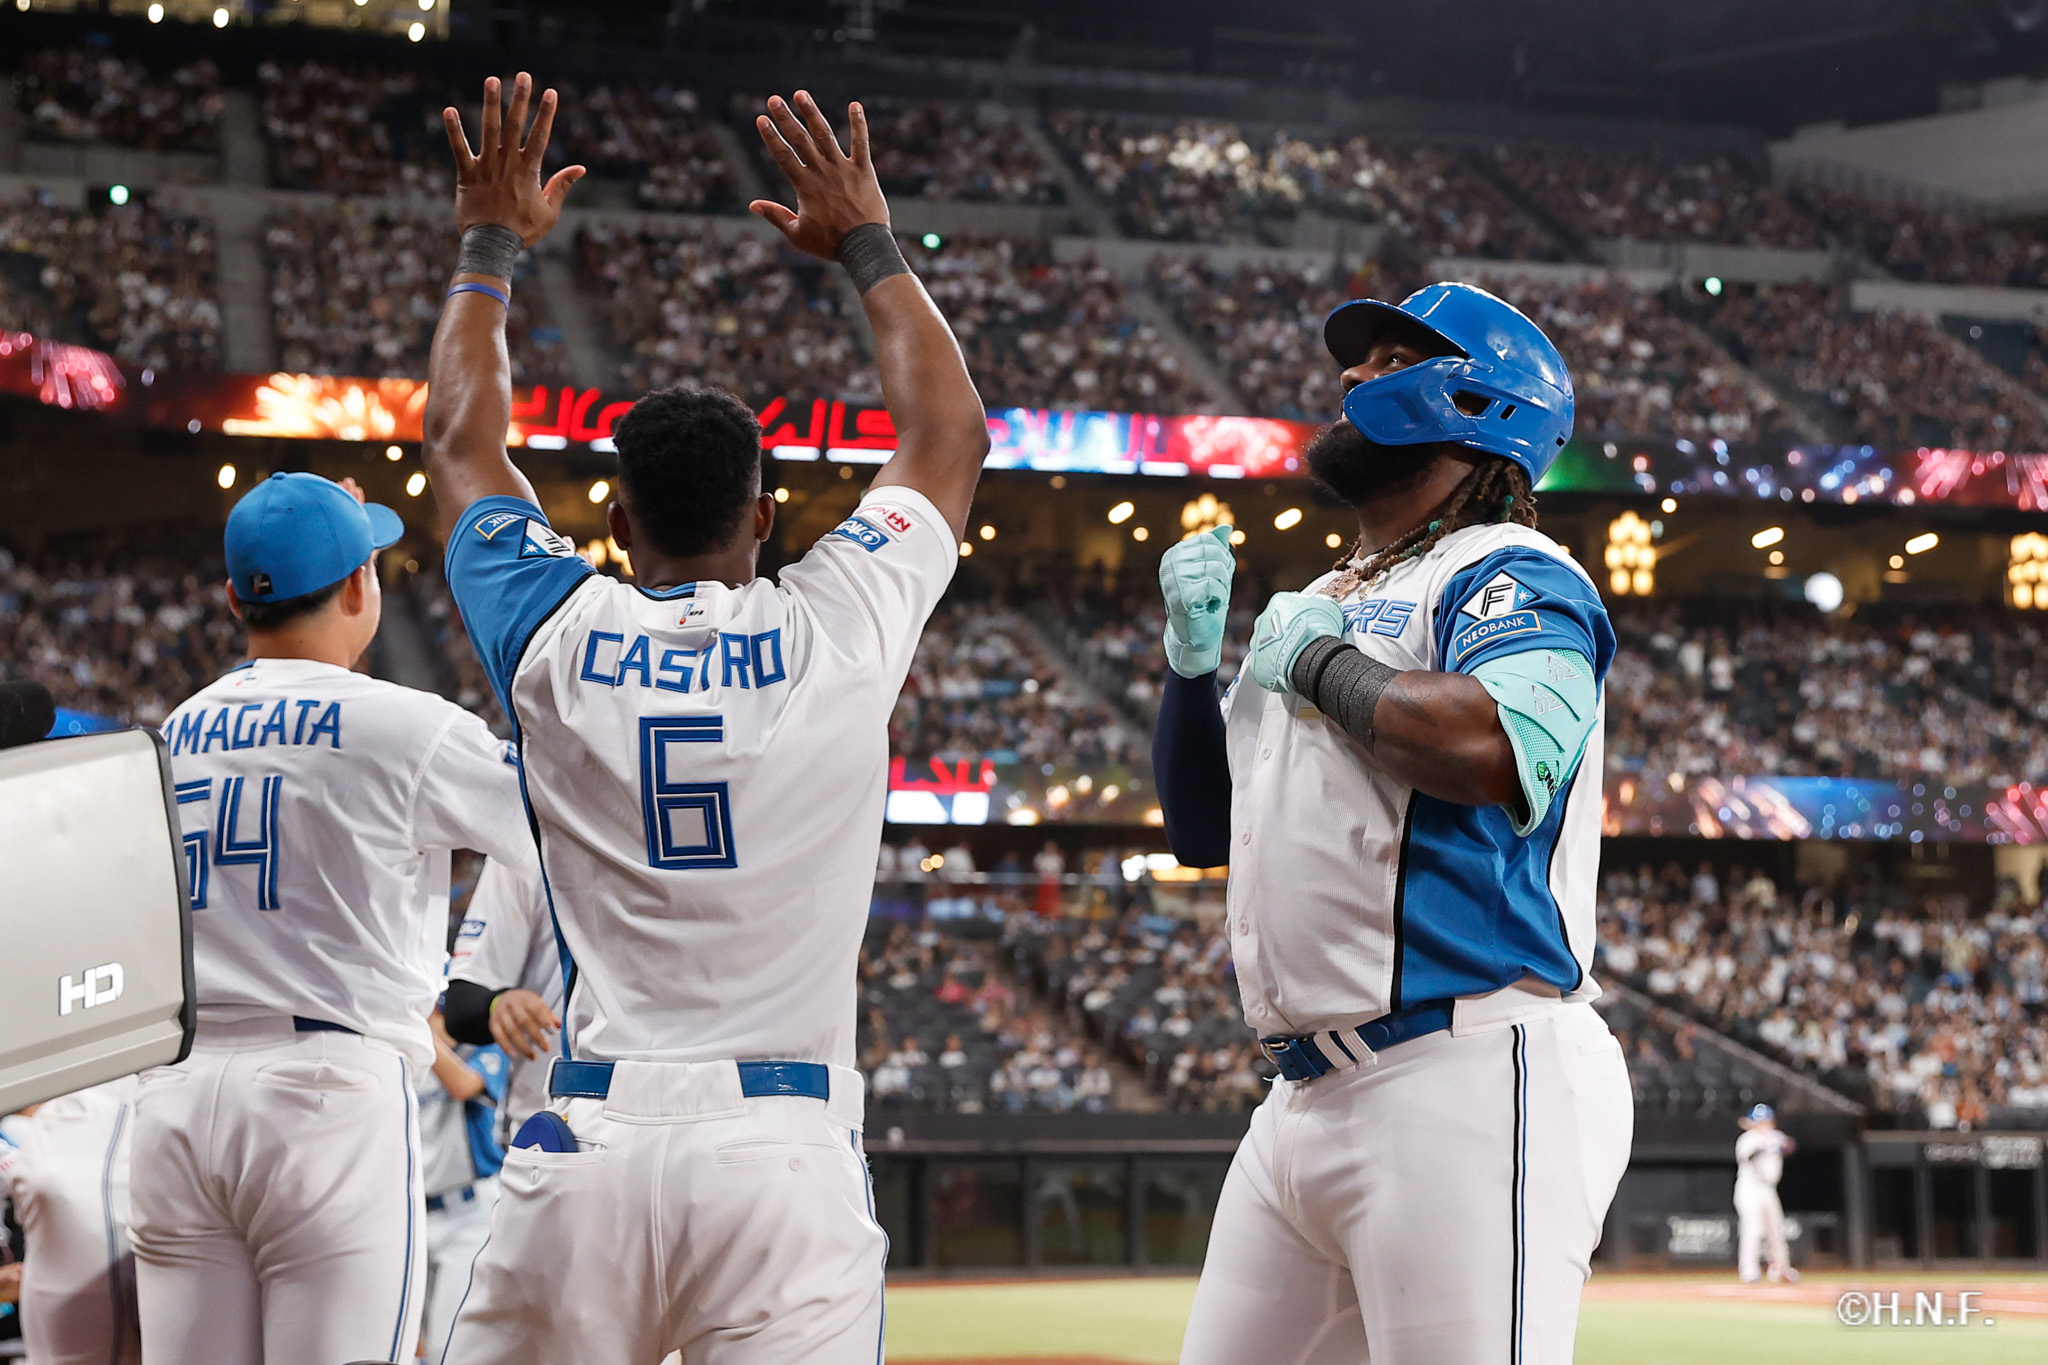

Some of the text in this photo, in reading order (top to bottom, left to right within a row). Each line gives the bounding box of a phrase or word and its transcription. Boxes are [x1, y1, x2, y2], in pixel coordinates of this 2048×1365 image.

[1480, 582, 1513, 617] F
[1462, 616, 1526, 647] NEOBANK
[160, 698, 342, 756] AMAGATA
[639, 715, 738, 870] 6
[59, 962, 124, 1016] HD
